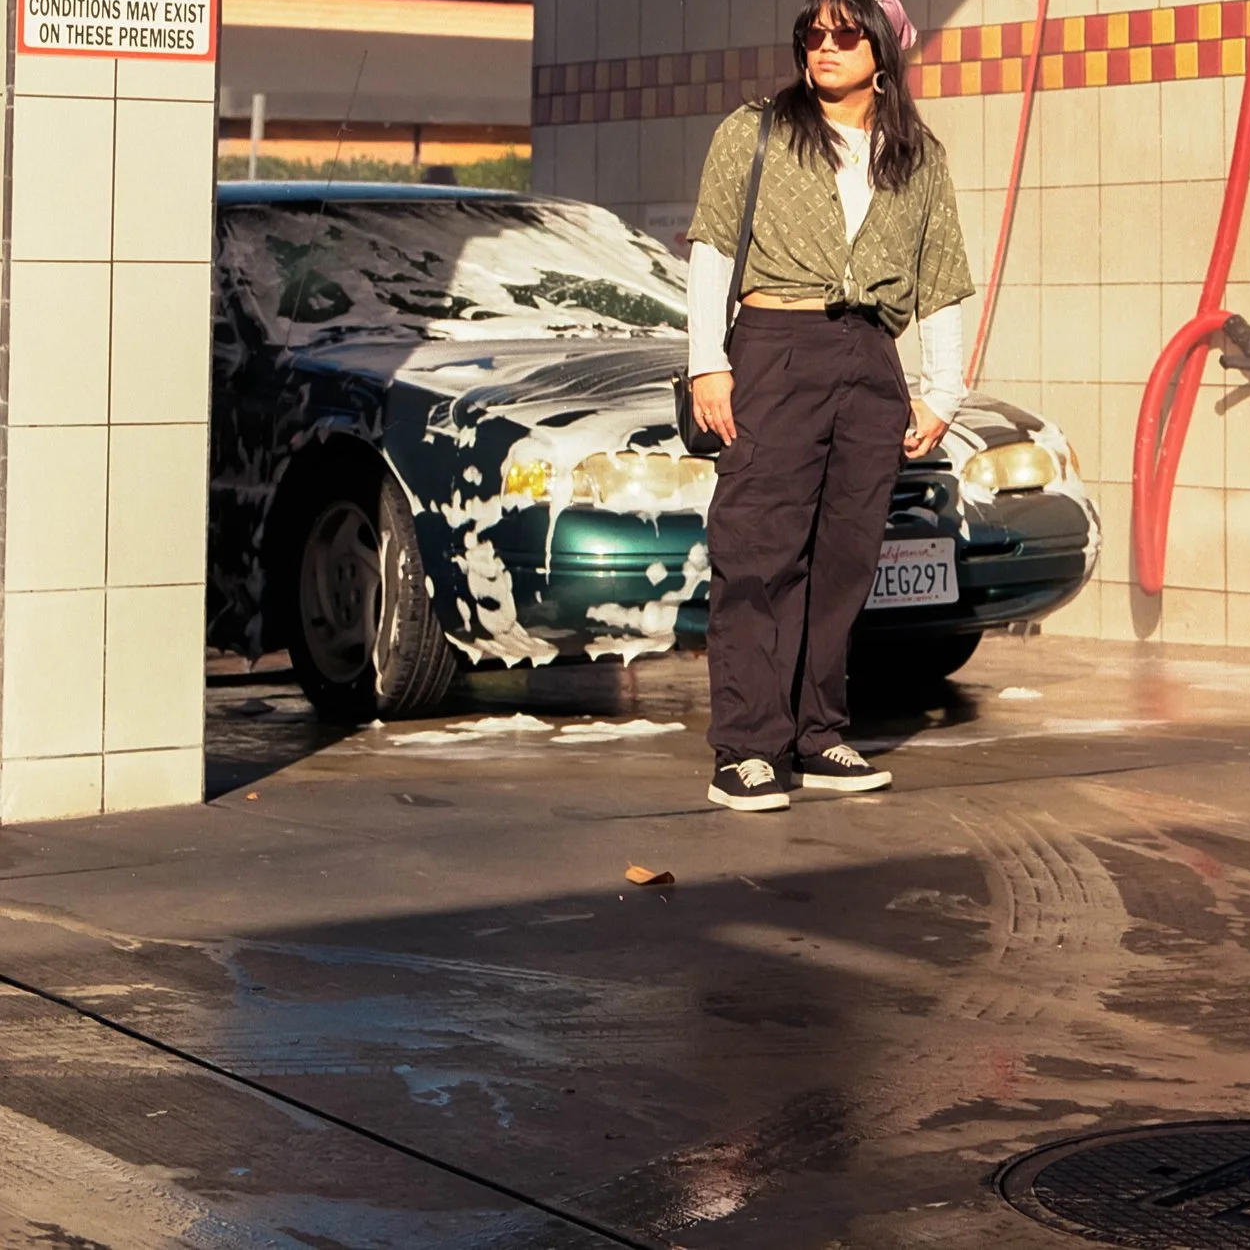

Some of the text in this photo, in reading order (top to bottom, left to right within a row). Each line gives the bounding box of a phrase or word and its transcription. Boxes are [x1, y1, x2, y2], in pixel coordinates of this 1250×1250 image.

[126, 1, 159, 22] MAY
[164, 2, 206, 24] EXIST
[39, 23, 195, 50] ON THESE PREMISES
[880, 546, 933, 564] alifornia
